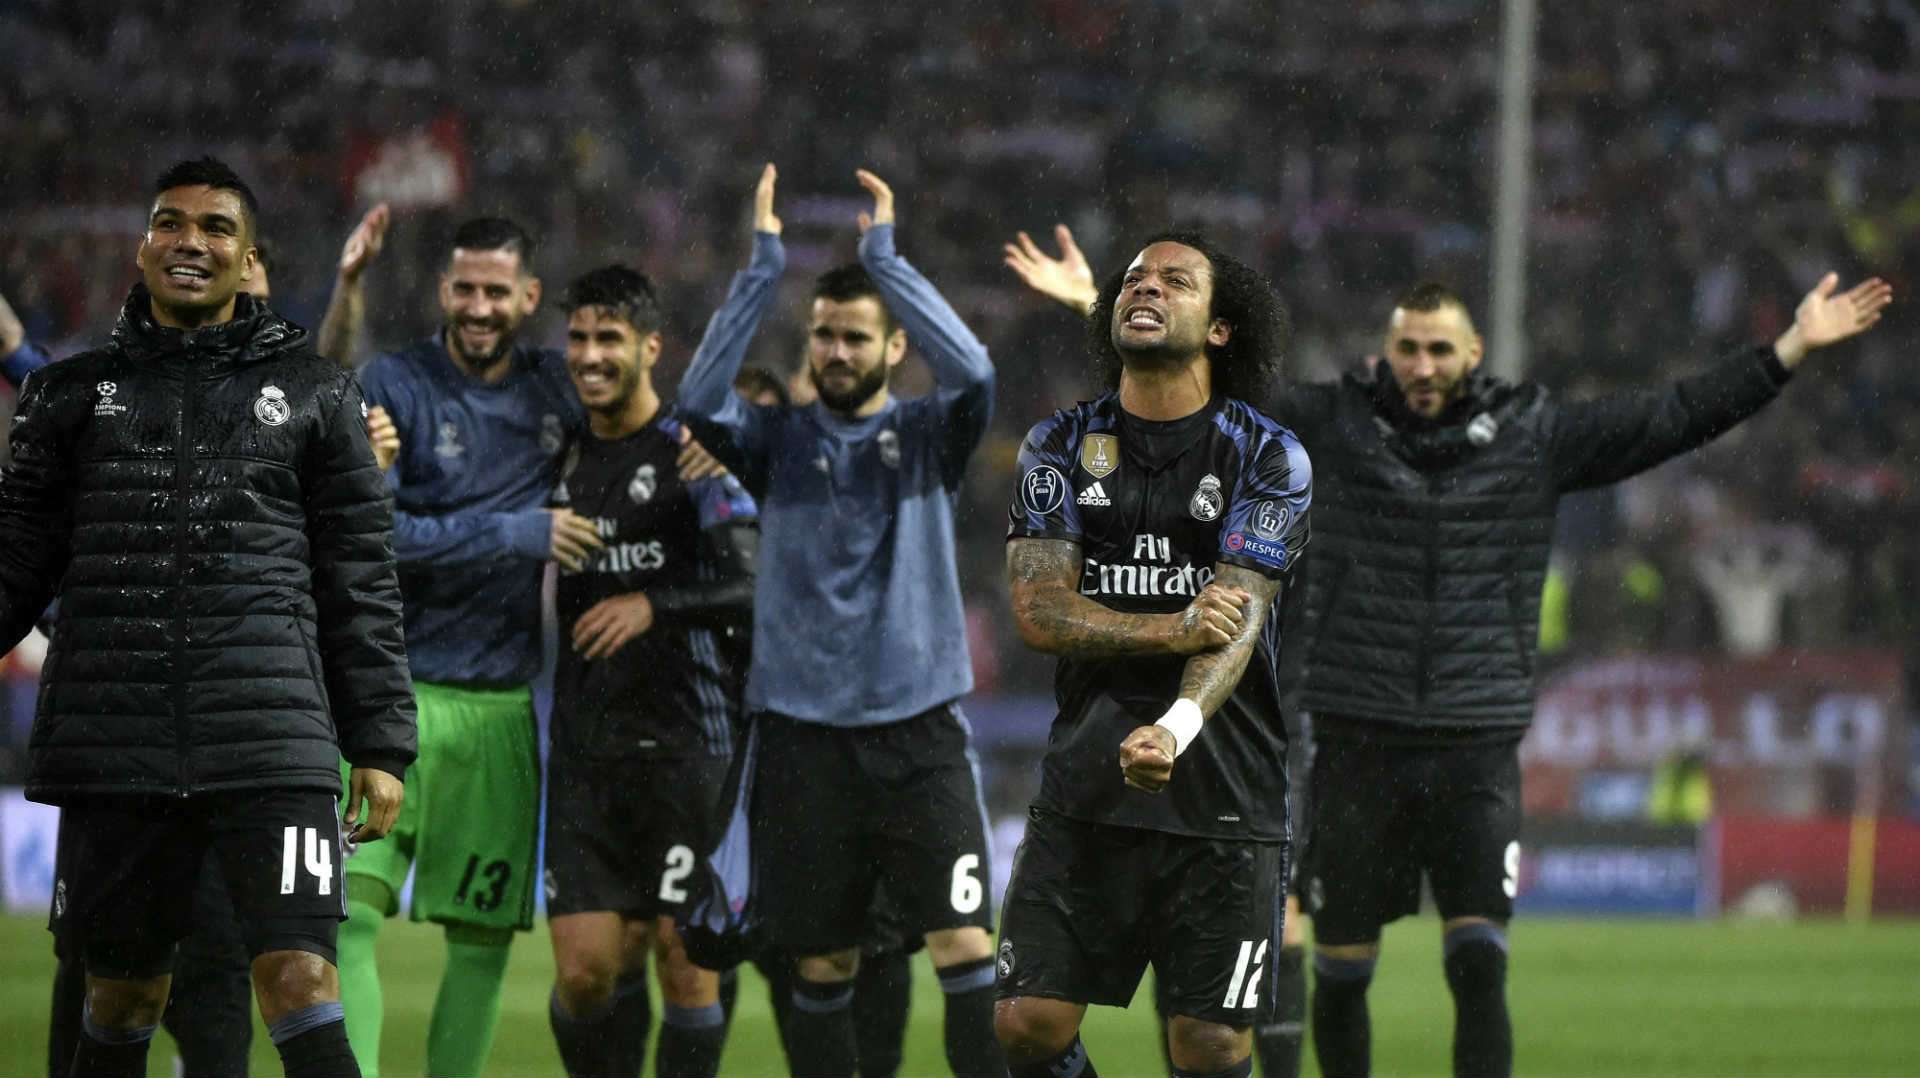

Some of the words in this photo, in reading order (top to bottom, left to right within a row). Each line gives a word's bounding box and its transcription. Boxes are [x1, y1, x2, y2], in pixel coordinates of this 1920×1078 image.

[94, 404, 127, 412] AMPIONS
[1076, 495, 1112, 506] adidas
[596, 516, 618, 538] ly
[1262, 516, 1277, 532] 11
[1133, 533, 1171, 564] Fly
[1244, 540, 1287, 560] RESPEC
[1081, 558, 1215, 597] Emirate
[280, 826, 333, 895] 14
[453, 852, 511, 911] 13
[950, 853, 983, 914] 6
[1222, 938, 1268, 1009] 12
